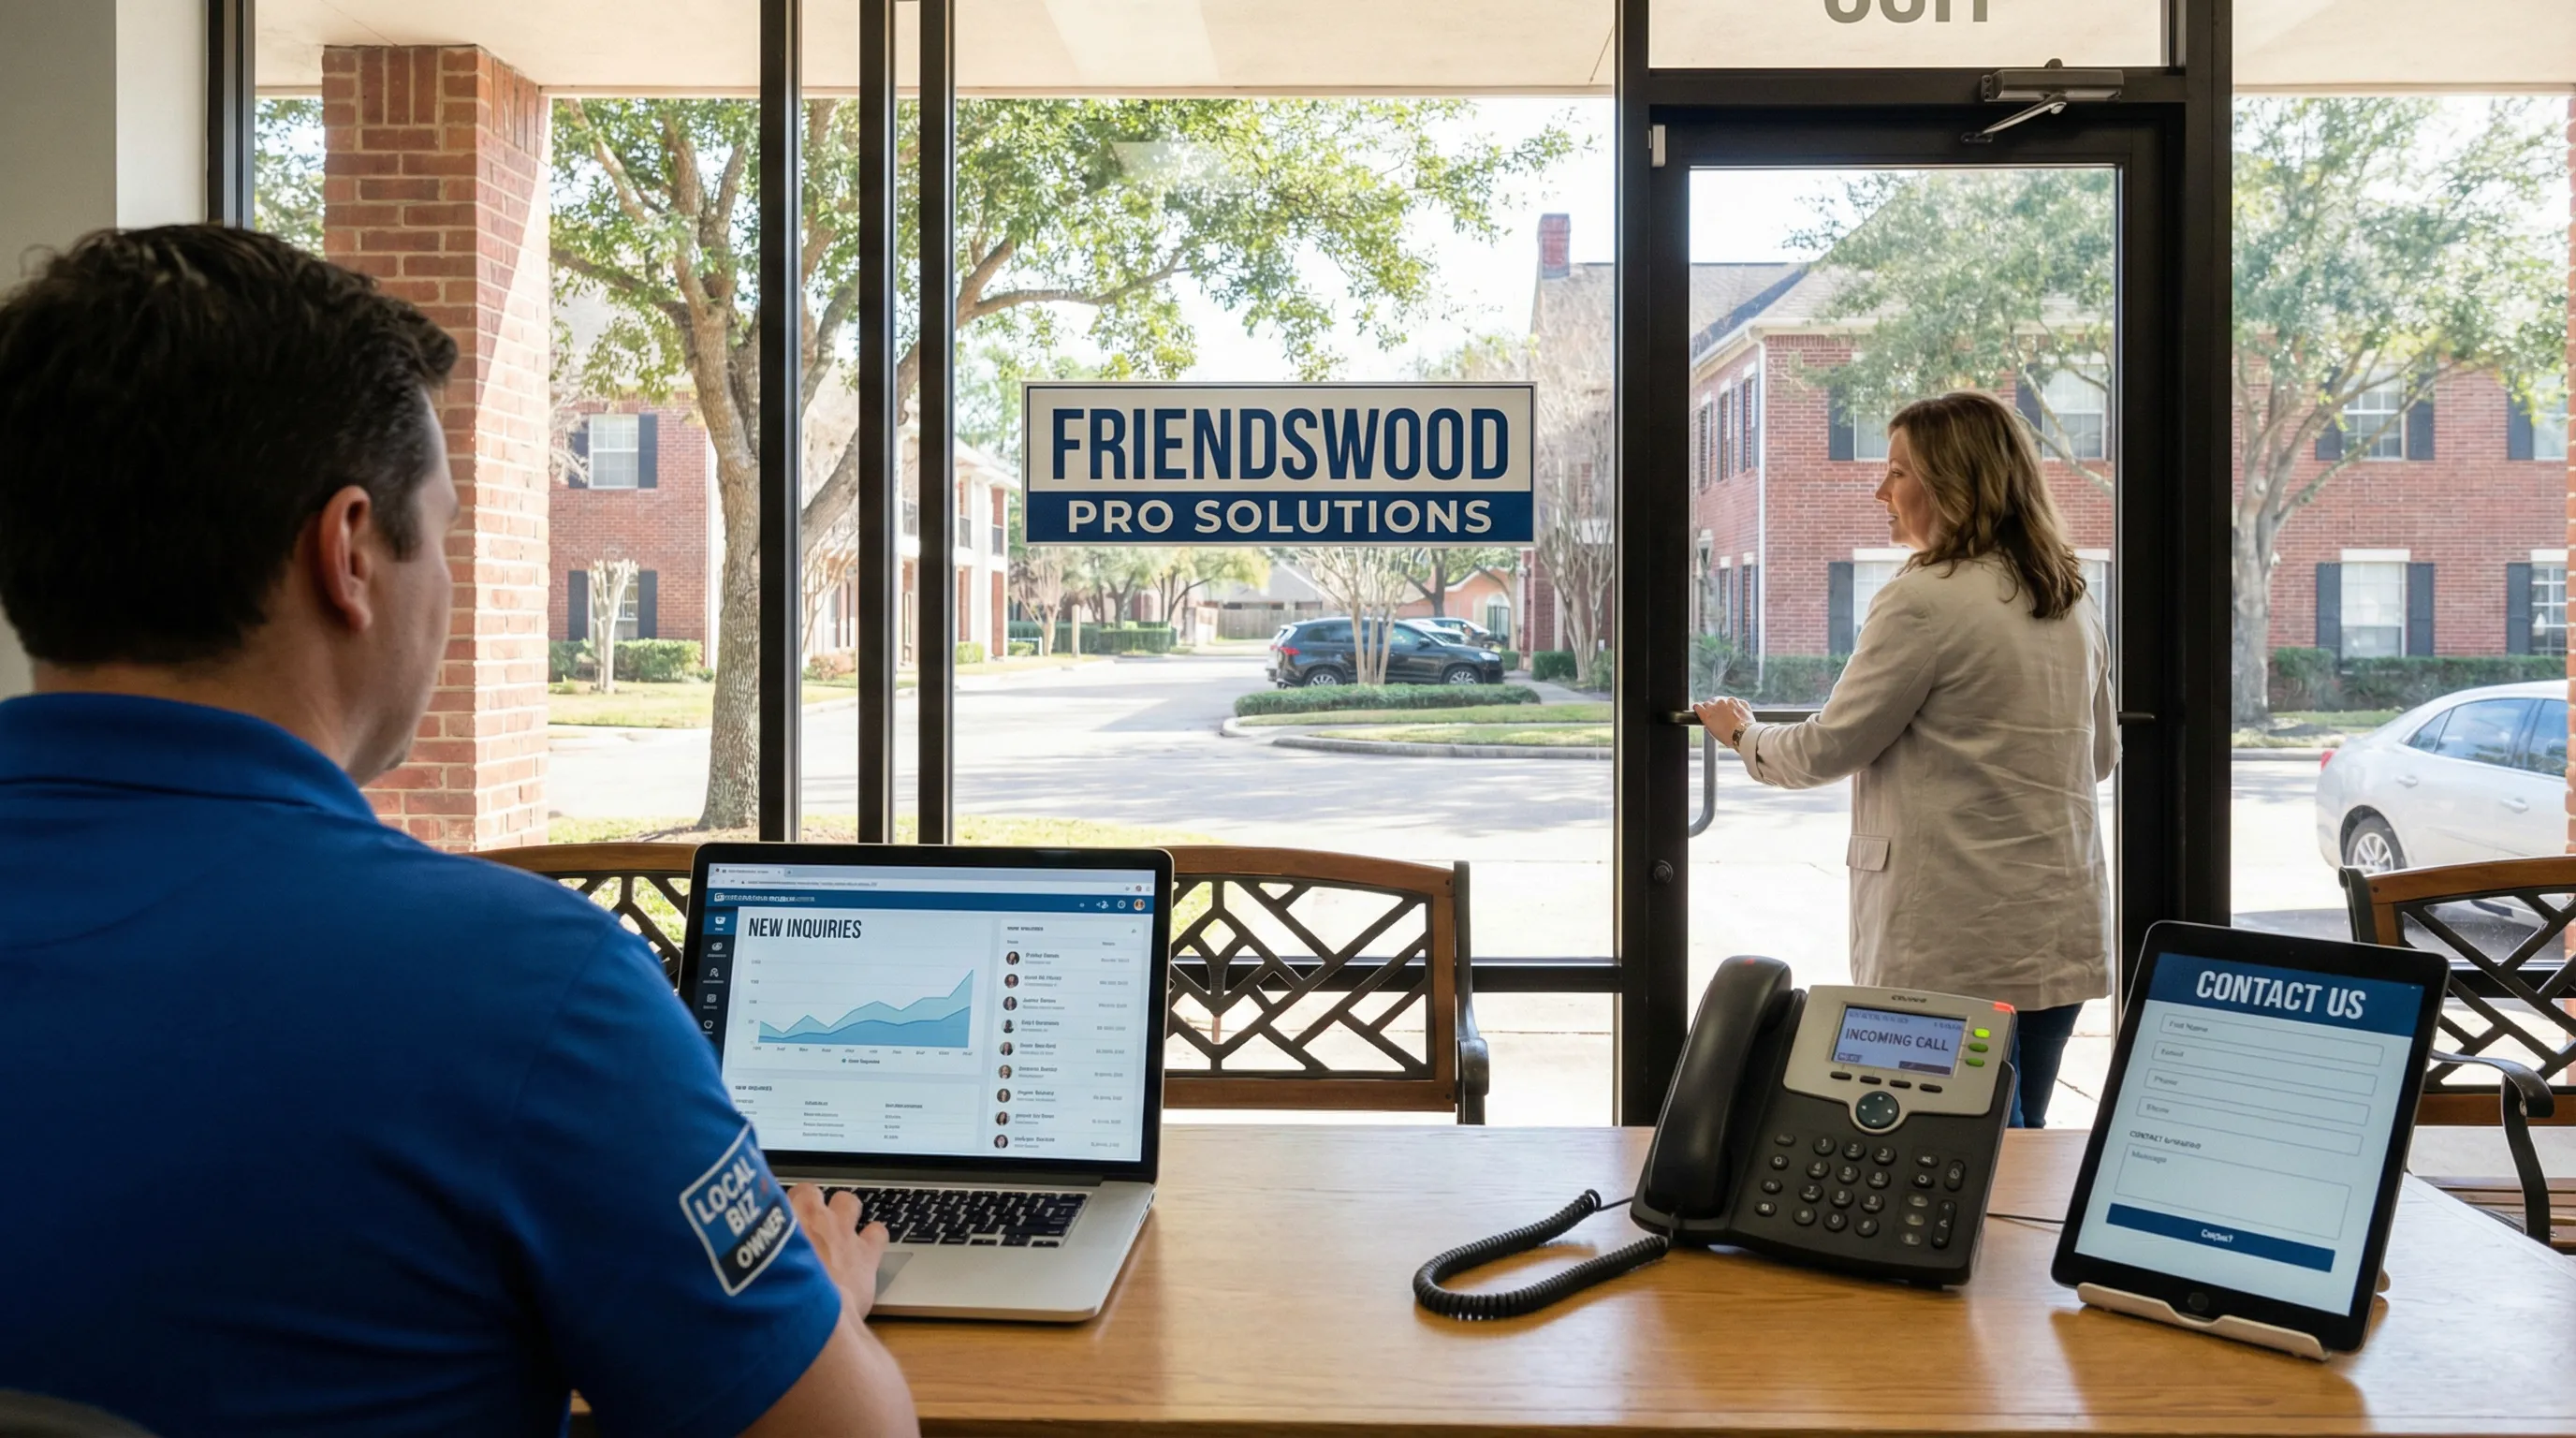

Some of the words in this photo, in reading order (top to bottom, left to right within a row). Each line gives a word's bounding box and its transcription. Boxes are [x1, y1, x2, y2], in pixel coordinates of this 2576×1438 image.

[1052, 407, 1509, 480] FRIENDSWOOD
[1068, 499, 1174, 534] PRO
[1194, 499, 1492, 534] SOLUTIONS
[749, 917, 783, 937] NEW
[786, 918, 862, 939] INQUIRIES
[2196, 970, 2322, 1014] CONTACT
[2326, 987, 2367, 1020] US
[1845, 1027, 1912, 1047] INCOMING
[1915, 1036, 1950, 1052] CALL
[695, 1156, 757, 1225] LOCAL
[725, 1188, 762, 1237] BIZ
[736, 1206, 786, 1269] OWNER
